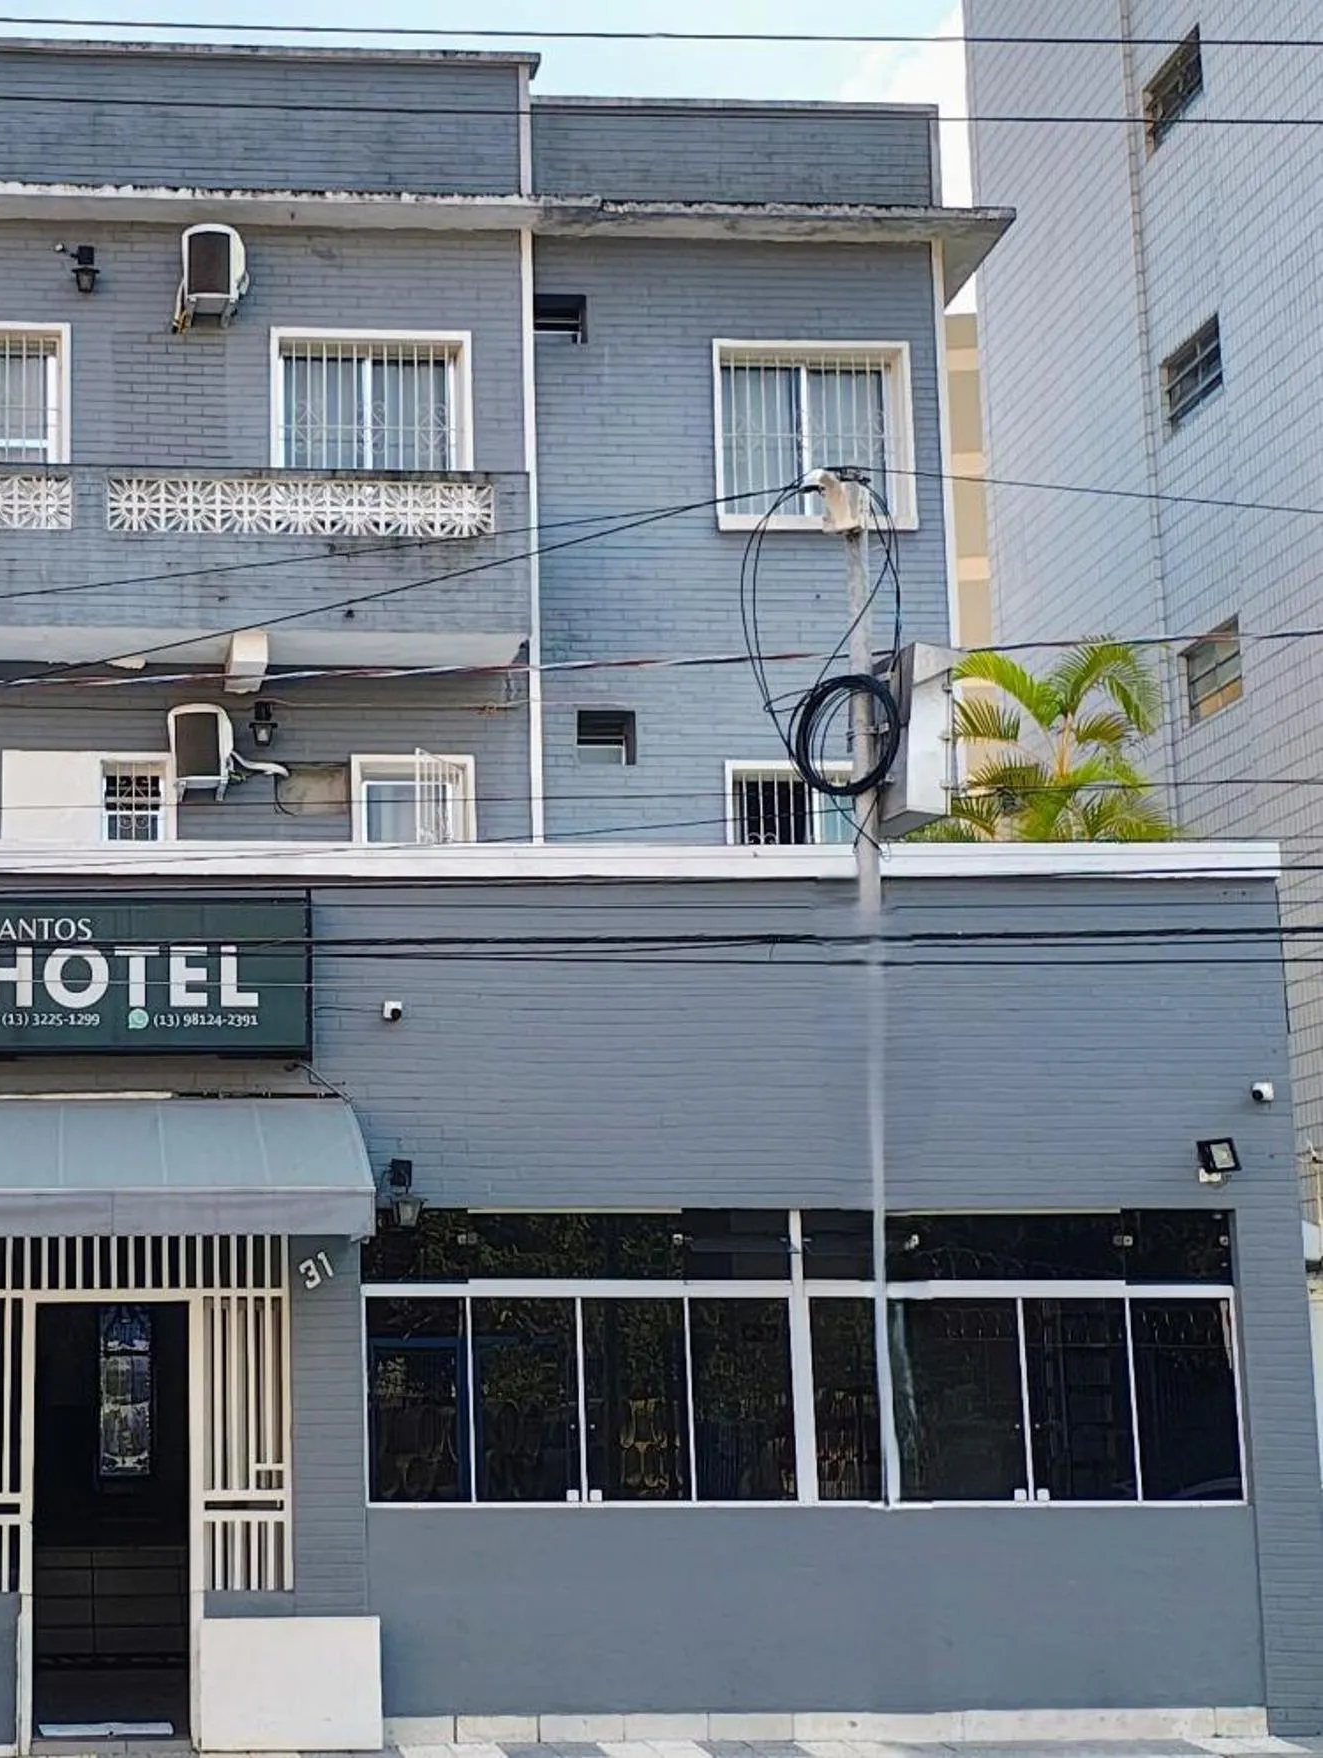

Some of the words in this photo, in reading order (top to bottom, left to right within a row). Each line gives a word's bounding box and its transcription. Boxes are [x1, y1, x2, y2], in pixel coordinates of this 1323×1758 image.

[1, 1012, 29, 1028] (13)
[32, 1013, 101, 1027] 3225-1299
[153, 1013, 180, 1028] (13)
[183, 1013, 259, 1028] 98124-2391
[299, 1251, 334, 1289] 31
